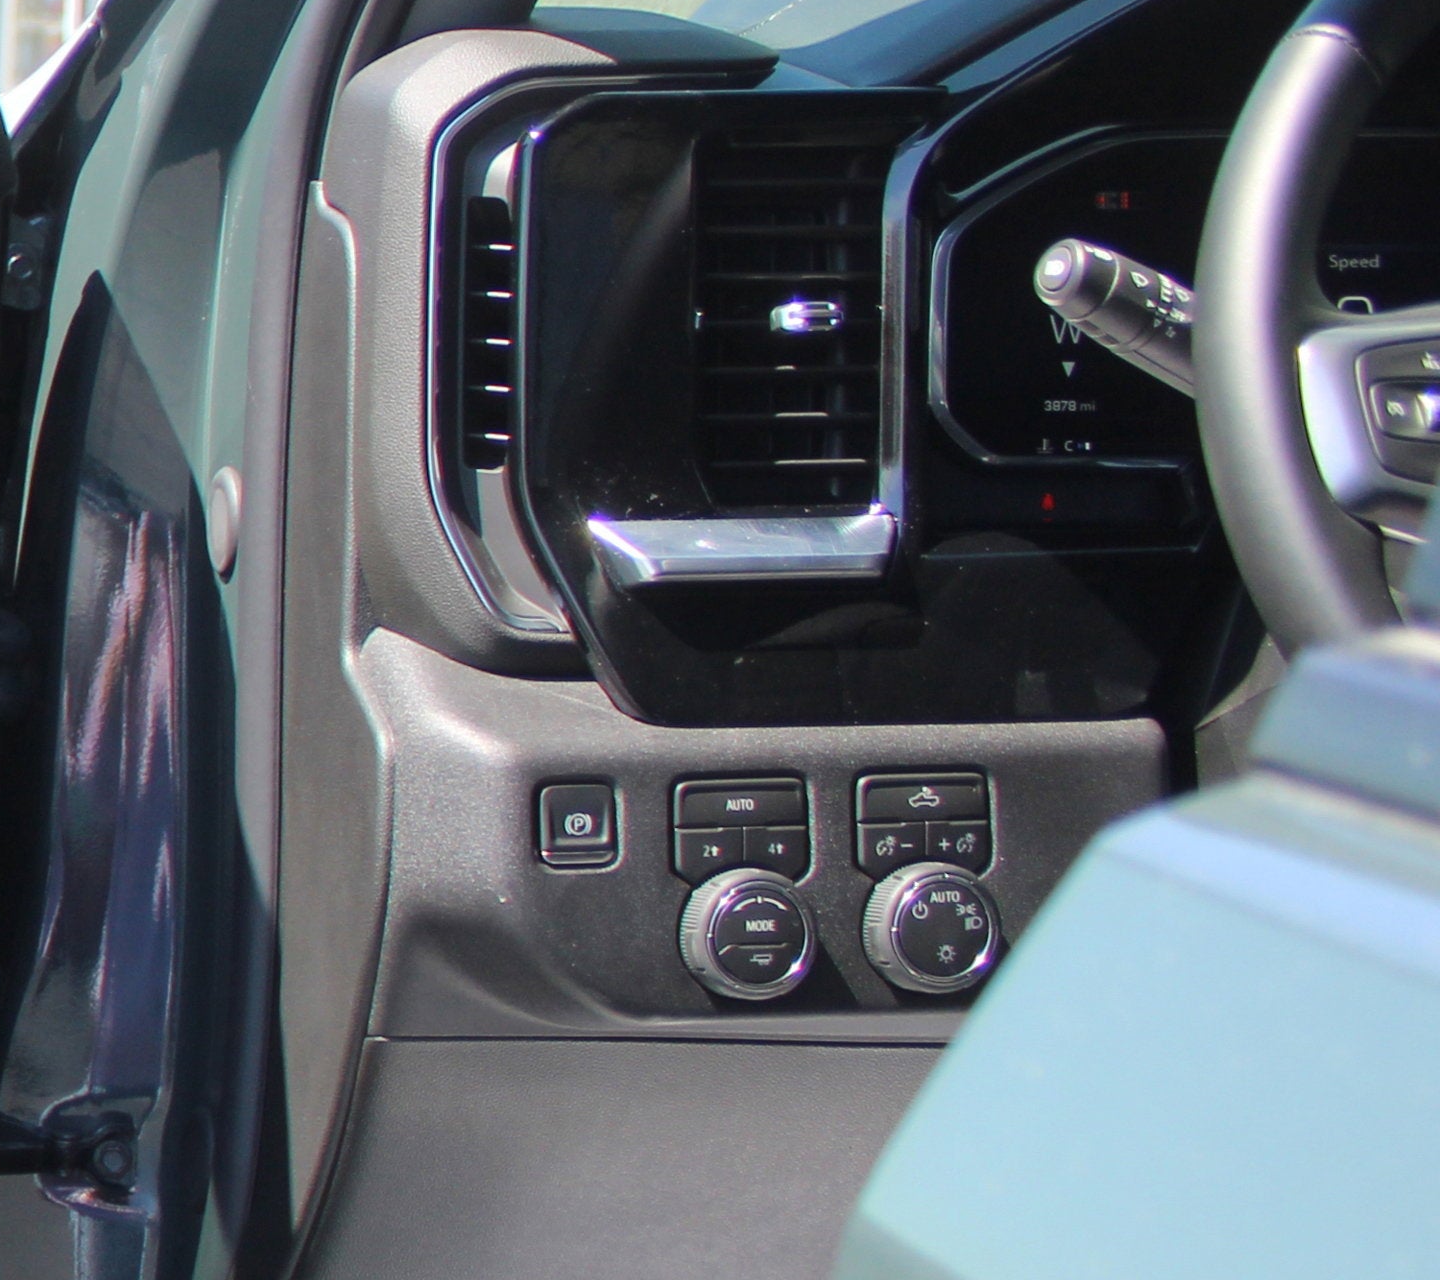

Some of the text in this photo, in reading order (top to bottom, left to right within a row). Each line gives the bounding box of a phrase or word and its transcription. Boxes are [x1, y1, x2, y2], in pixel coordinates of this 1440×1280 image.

[1328, 254, 1380, 271] Speed
[1079, 400, 1096, 412] mi
[1064, 440, 1074, 452] C
[726, 798, 755, 811] AUTO
[929, 890, 961, 903] AUTO
[745, 919, 777, 933] MODE
